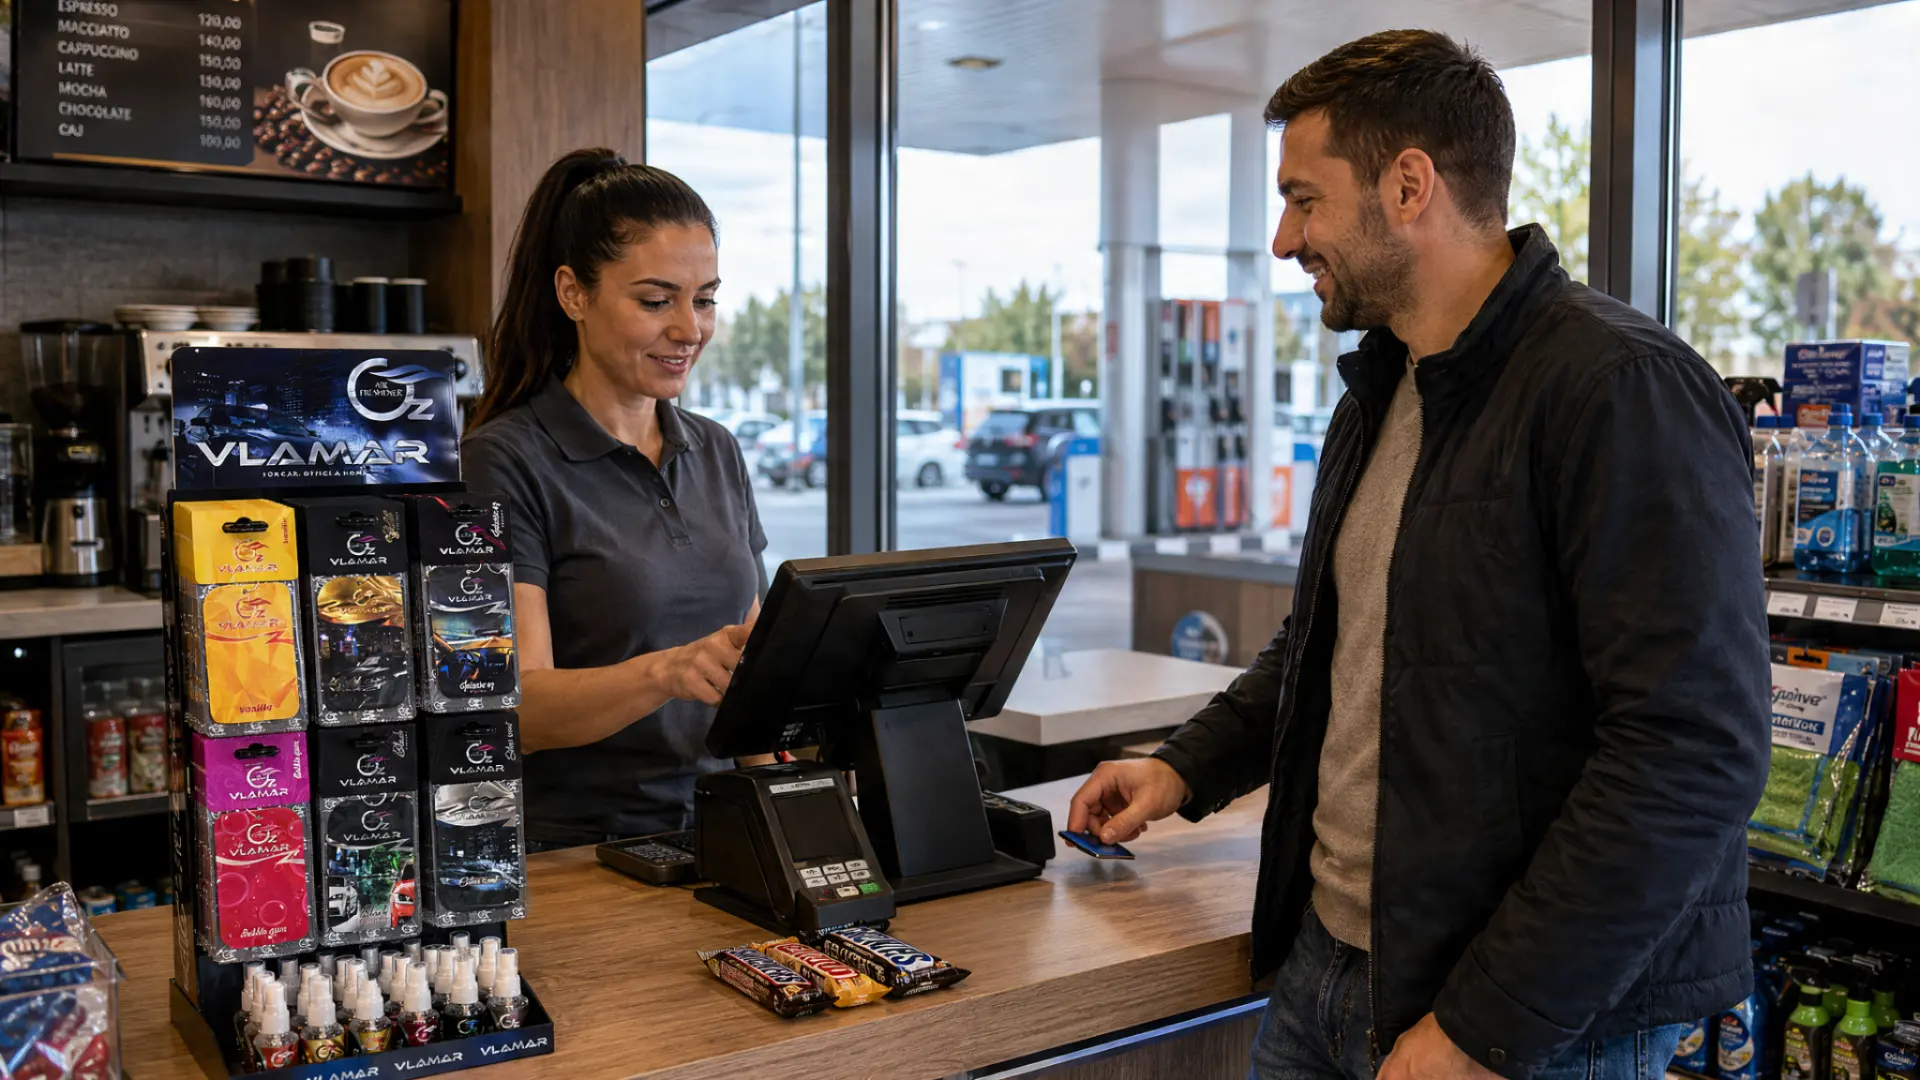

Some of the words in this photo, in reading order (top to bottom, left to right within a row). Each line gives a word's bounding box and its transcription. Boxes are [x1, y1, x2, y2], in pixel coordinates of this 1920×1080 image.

[58, 0, 118, 17] ESPRESSO
[198, 13, 242, 30] 120,00
[58, 19, 130, 39] MACCIATTO
[57, 40, 139, 60] CAPPUCCINO
[58, 61, 95, 77] LATTE
[58, 81, 108, 98] MOCHA
[58, 101, 132, 120] CHOCOLATE
[195, 440, 430, 467] VLAMAR
[439, 546, 494, 555] VLAMAR
[329, 557, 388, 566] VLAMAR
[450, 764, 505, 775] VLAMAR
[339, 776, 397, 787] VLAMAR
[229, 788, 289, 800] VLAMAR
[229, 843, 289, 857] VLAMAR
[394, 1052, 463, 1071] VLAMAR
[480, 1037, 548, 1056] VLAMAR
